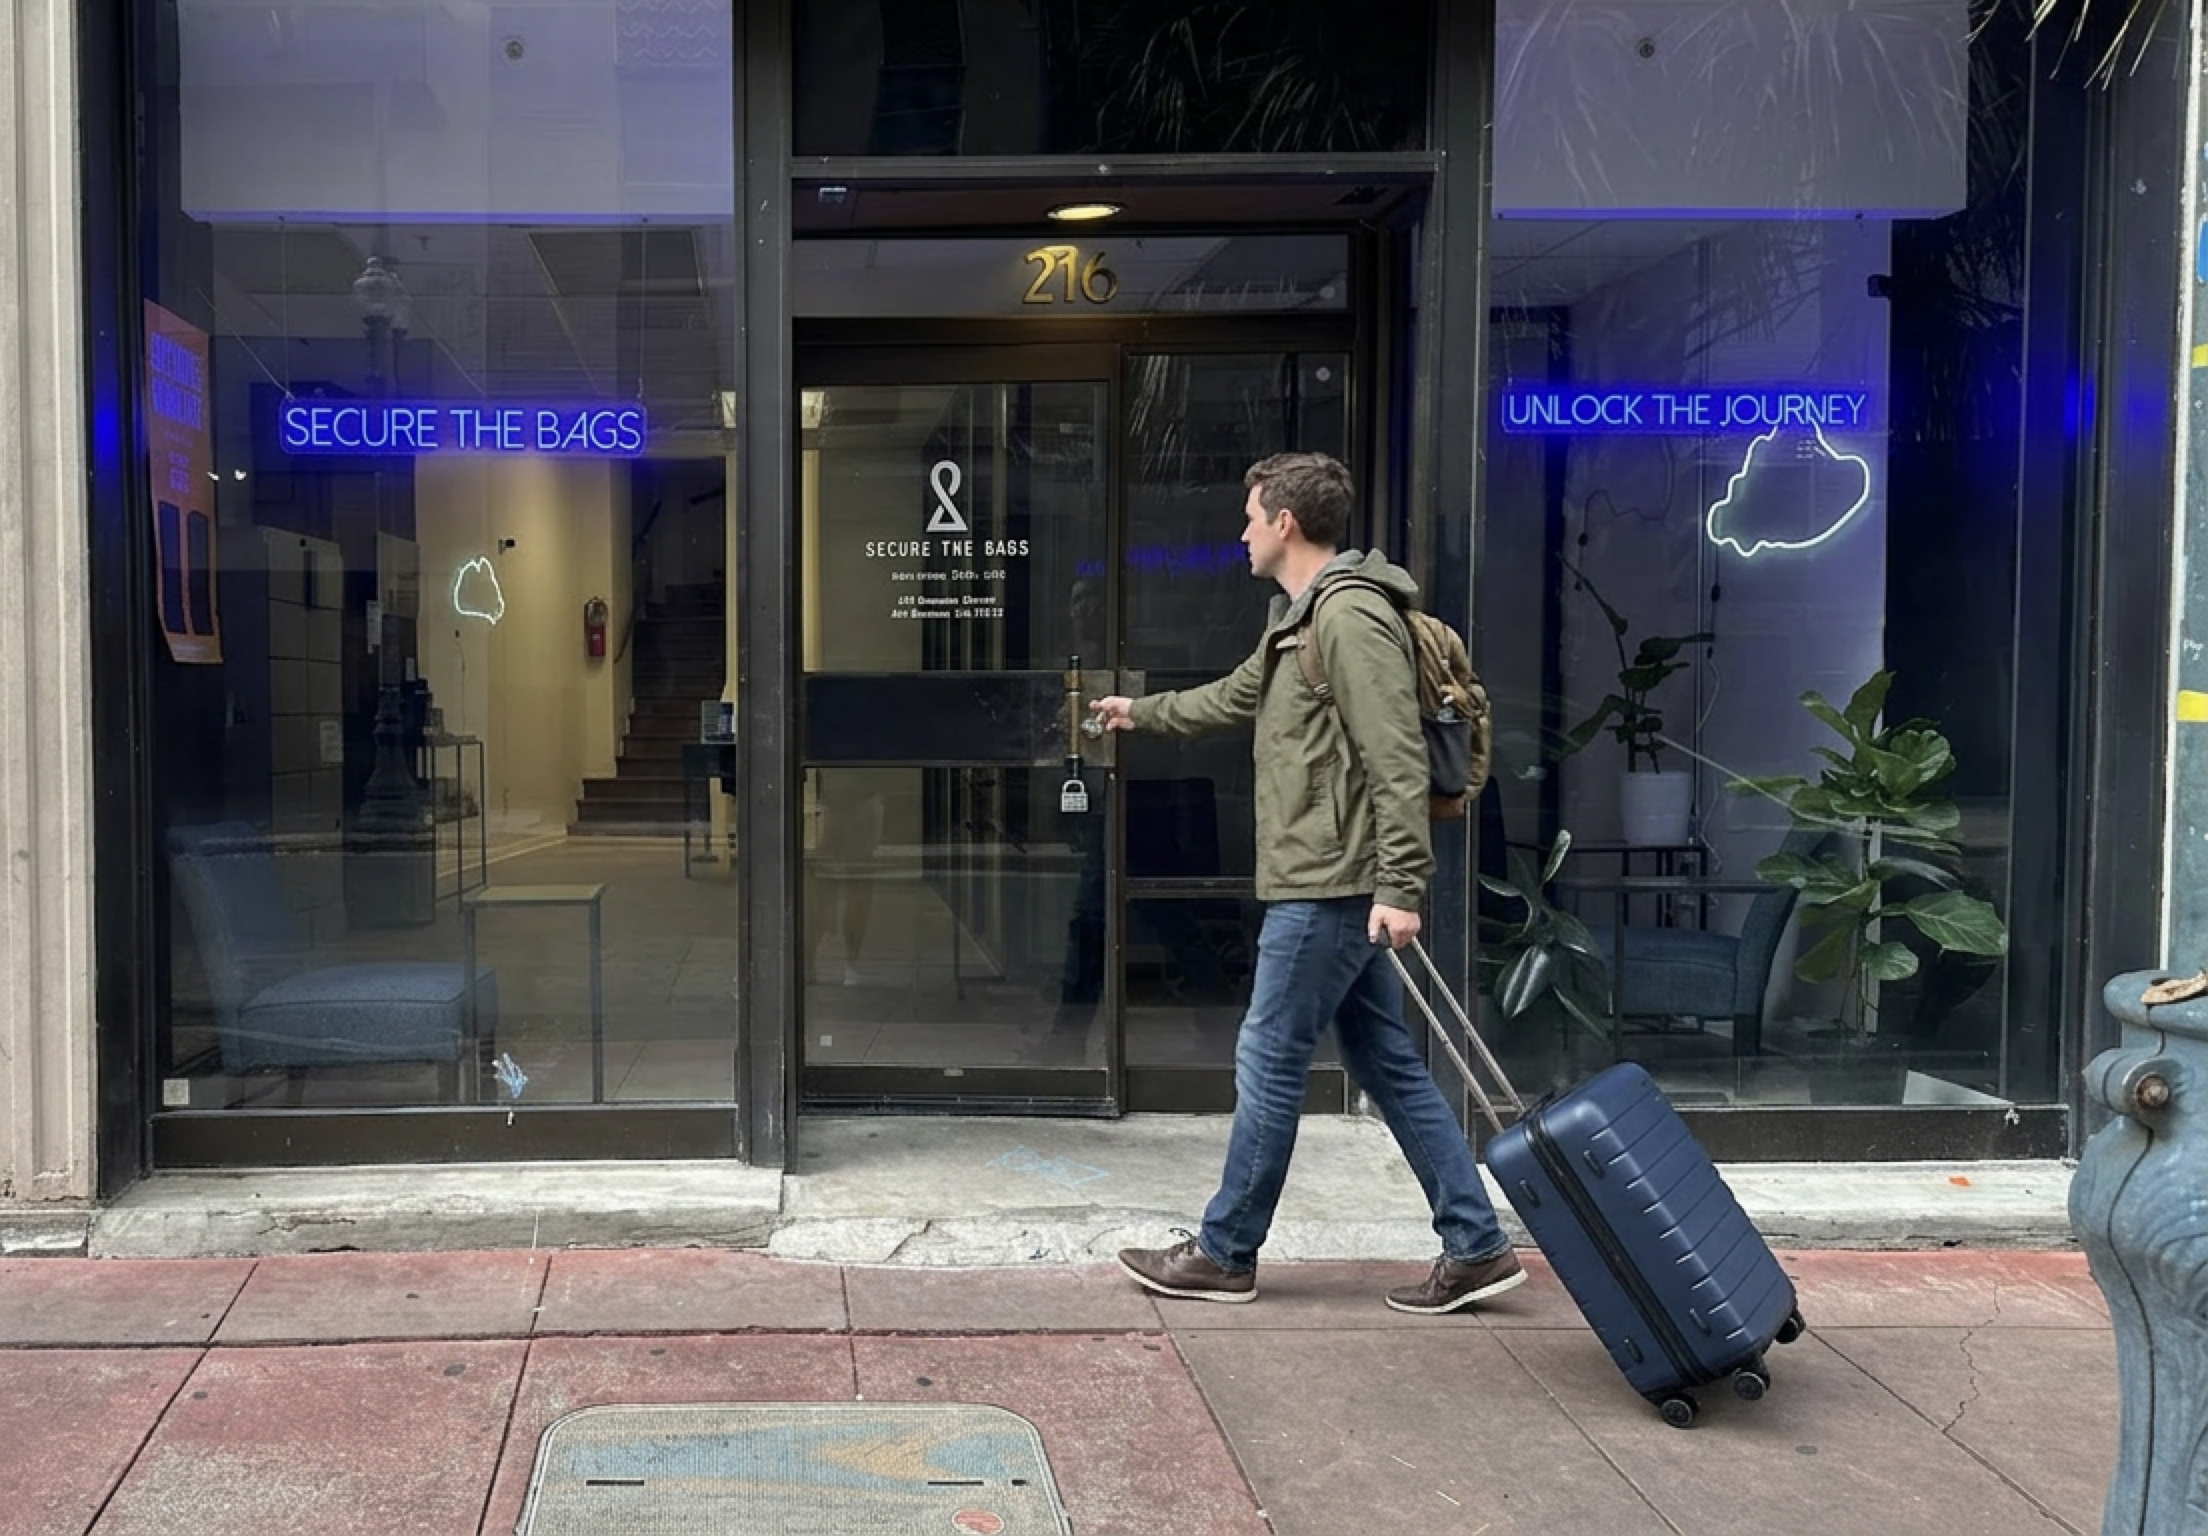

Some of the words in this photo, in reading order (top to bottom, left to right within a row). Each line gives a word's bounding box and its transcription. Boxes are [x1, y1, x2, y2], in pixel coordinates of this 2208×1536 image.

[1022, 244, 1119, 305] 216
[285, 407, 439, 447] SECURE
[449, 409, 525, 450] THE
[536, 410, 641, 450] BAGS
[1508, 394, 1643, 426] UNLOCK
[1651, 394, 1711, 426] THE
[1719, 394, 1866, 427] JOURNEY
[865, 540, 931, 558] SECURE
